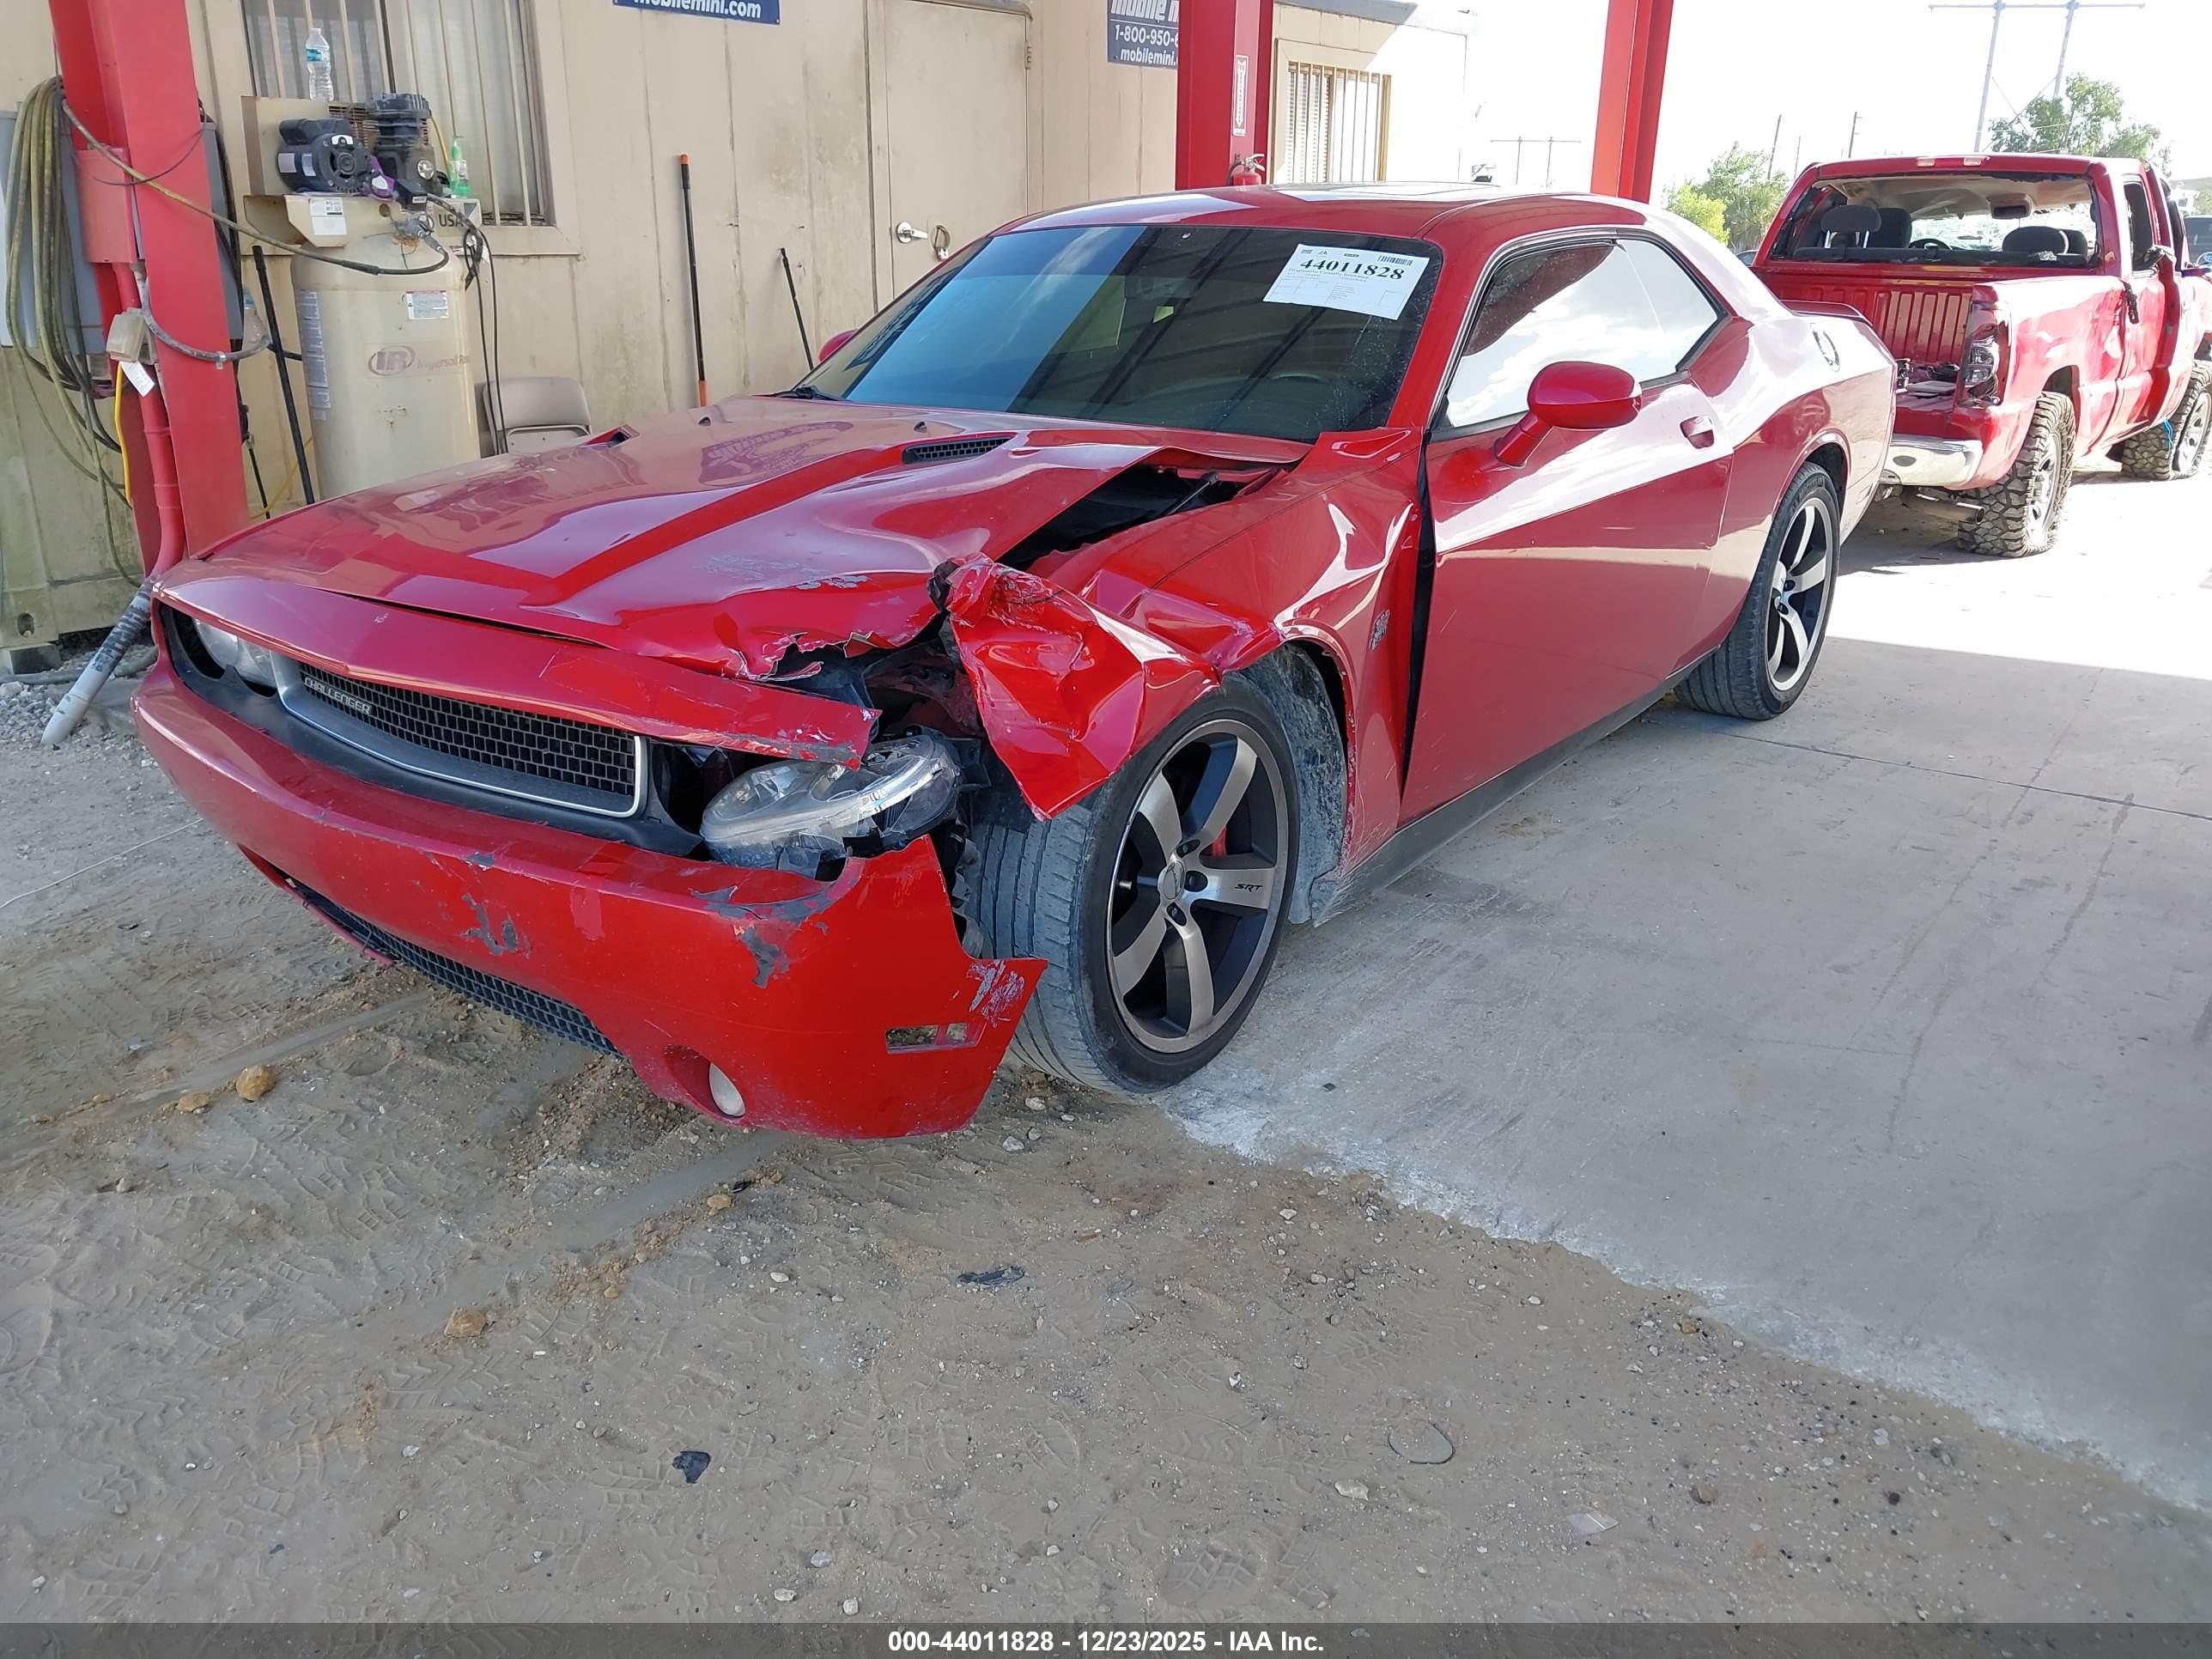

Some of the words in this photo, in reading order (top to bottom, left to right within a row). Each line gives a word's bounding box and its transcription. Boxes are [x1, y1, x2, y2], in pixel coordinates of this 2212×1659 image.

[635, 0, 762, 19] emini.com
[1115, 24, 1179, 48] 1-800-950-6
[1120, 46, 1179, 66] mobilemini.
[1300, 258, 1405, 280] 44011828
[304, 676, 372, 715] CHALLENGER
[1234, 883, 1264, 893] SRT
